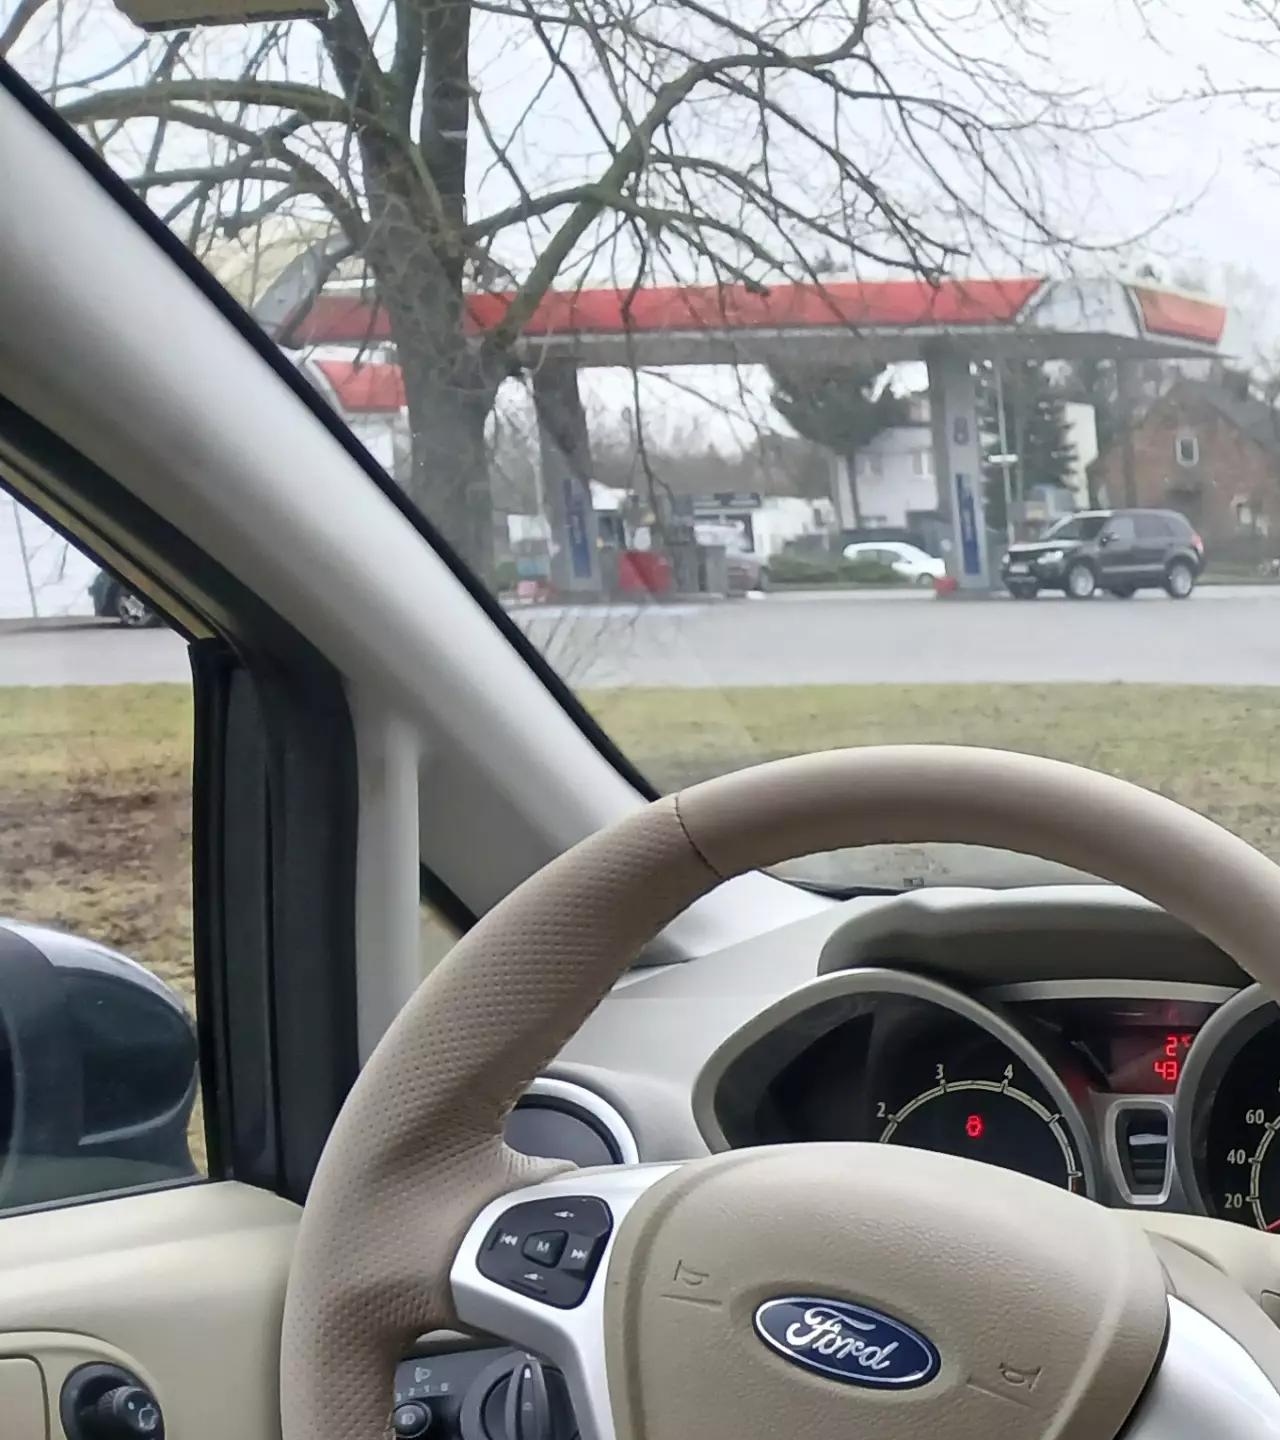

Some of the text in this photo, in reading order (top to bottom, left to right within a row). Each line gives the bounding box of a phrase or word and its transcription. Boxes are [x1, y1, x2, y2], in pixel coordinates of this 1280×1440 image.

[935, 1064, 944, 1079] 3
[1004, 1064, 1013, 1079] 4
[876, 1102, 886, 1118] 2
[1245, 1109, 1265, 1124] 60
[1226, 1149, 1246, 1165] 40
[1224, 1193, 1243, 1209] 20
[786, 1307, 899, 1370] Ford
